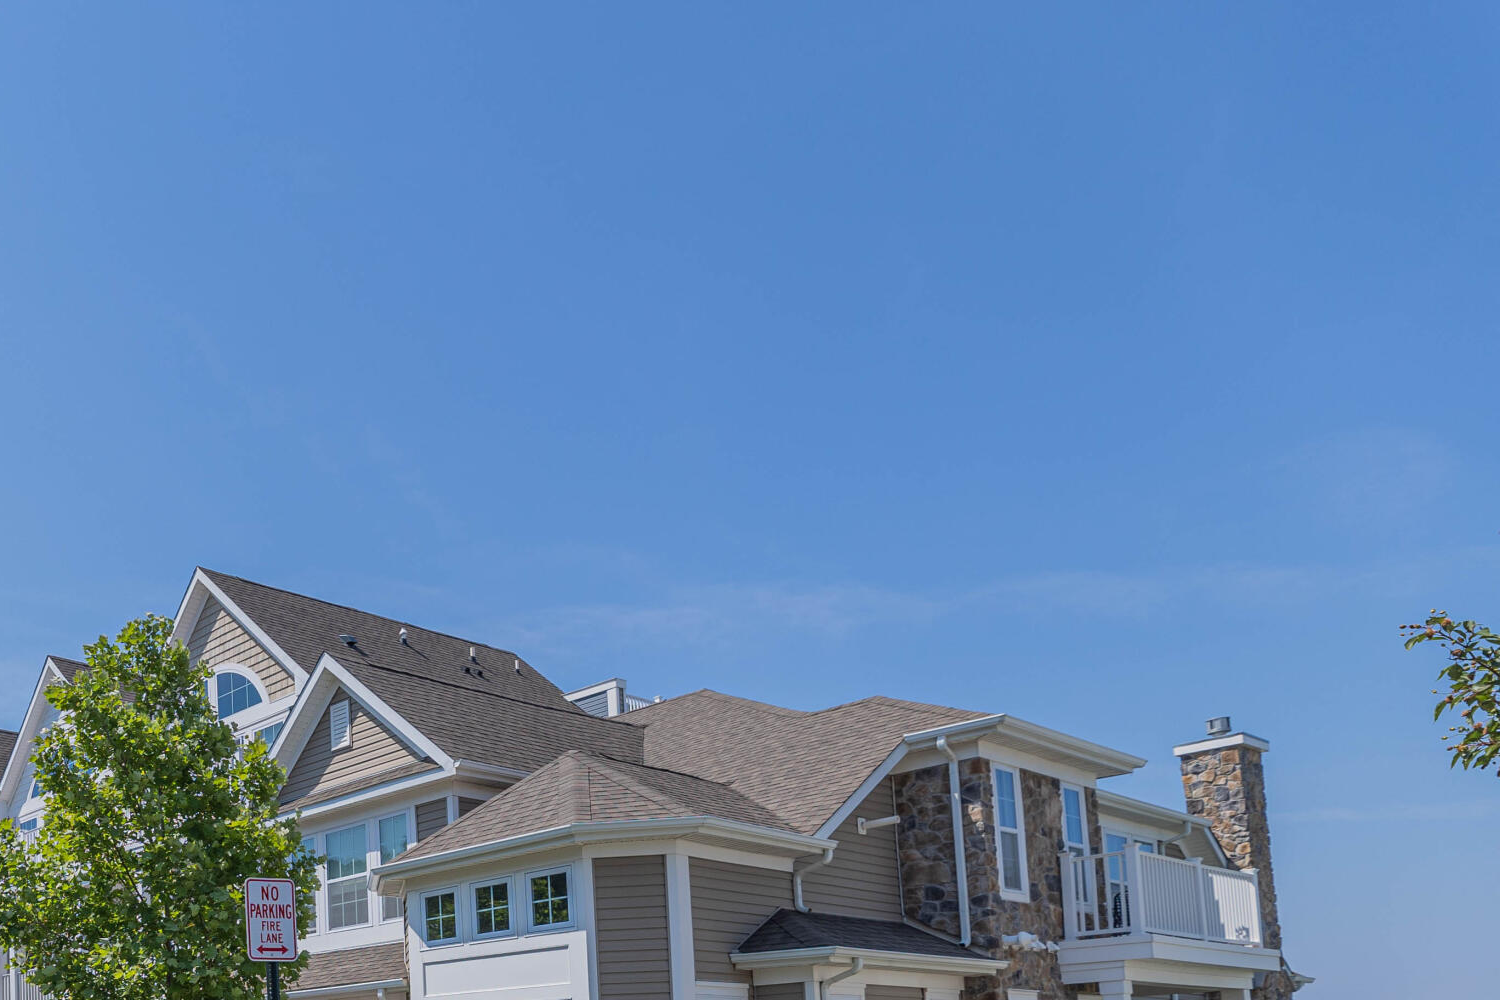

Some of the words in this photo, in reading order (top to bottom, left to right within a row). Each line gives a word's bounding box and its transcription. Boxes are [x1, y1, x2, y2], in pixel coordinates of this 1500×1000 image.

[261, 886, 279, 901] NO
[250, 904, 292, 919] PARKING
[261, 921, 281, 931] FIRE
[260, 933, 283, 943] LANE
